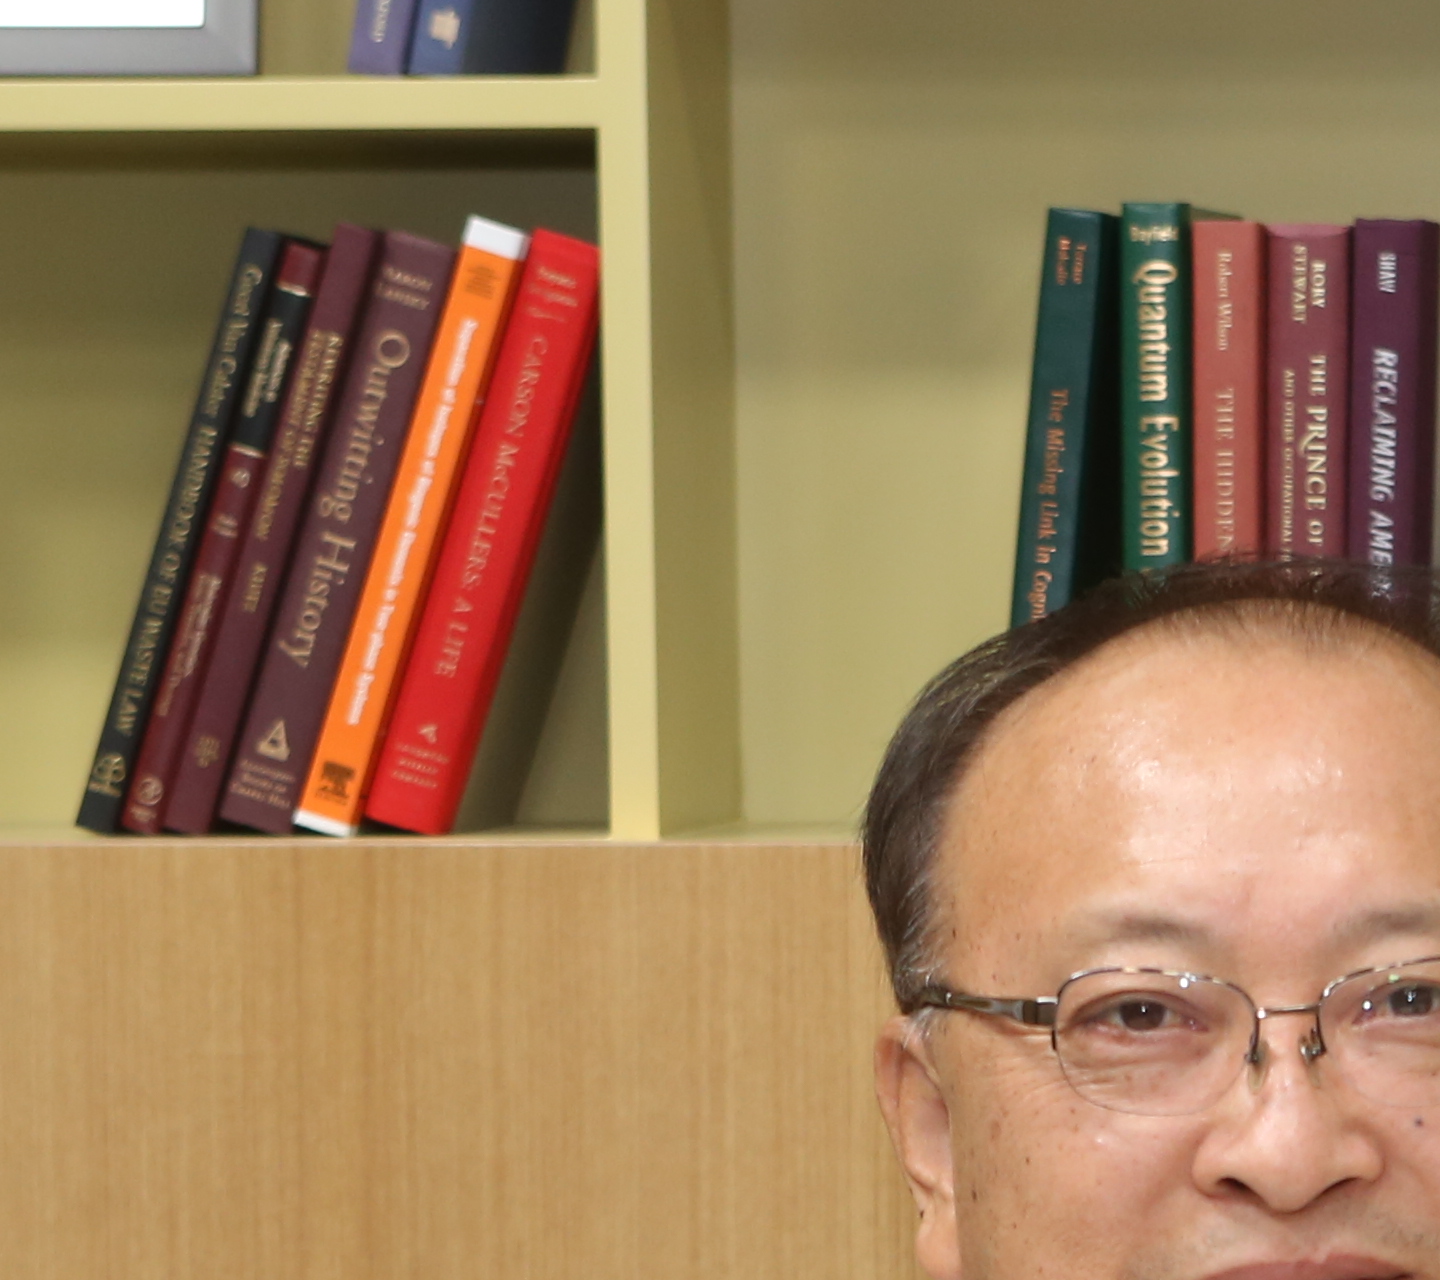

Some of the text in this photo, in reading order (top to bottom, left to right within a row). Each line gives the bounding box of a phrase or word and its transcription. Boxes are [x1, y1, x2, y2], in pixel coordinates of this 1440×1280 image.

[1216, 250, 1232, 297] Robert
[1292, 244, 1307, 324] STEWART
[1377, 250, 1397, 293] SHAW
[1217, 301, 1233, 351] Wilson
[504, 334, 549, 438] CARSON
[1282, 368, 1295, 395] AND
[1309, 353, 1326, 396] THE
[315, 322, 415, 526] Outwitting
[1132, 259, 1180, 556] Quantum Evolution
[1214, 387, 1234, 440] THE
[1281, 399, 1295, 443] OTHER
[1368, 347, 1398, 502] RECLAIMING
[165, 423, 219, 549] HANDBOOK
[1298, 404, 1328, 510] PRINCE
[1025, 387, 1069, 623] The Missing Link in Cogni
[1281, 446, 1294, 544] OCCUPATIONAL
[156, 546, 183, 579] OF
[147, 580, 173, 613] EU
[273, 526, 356, 671] History
[453, 594, 475, 616] A
[125, 612, 163, 686] WASTE
[434, 617, 468, 679] LIFE
[111, 684, 142, 735] LAW
